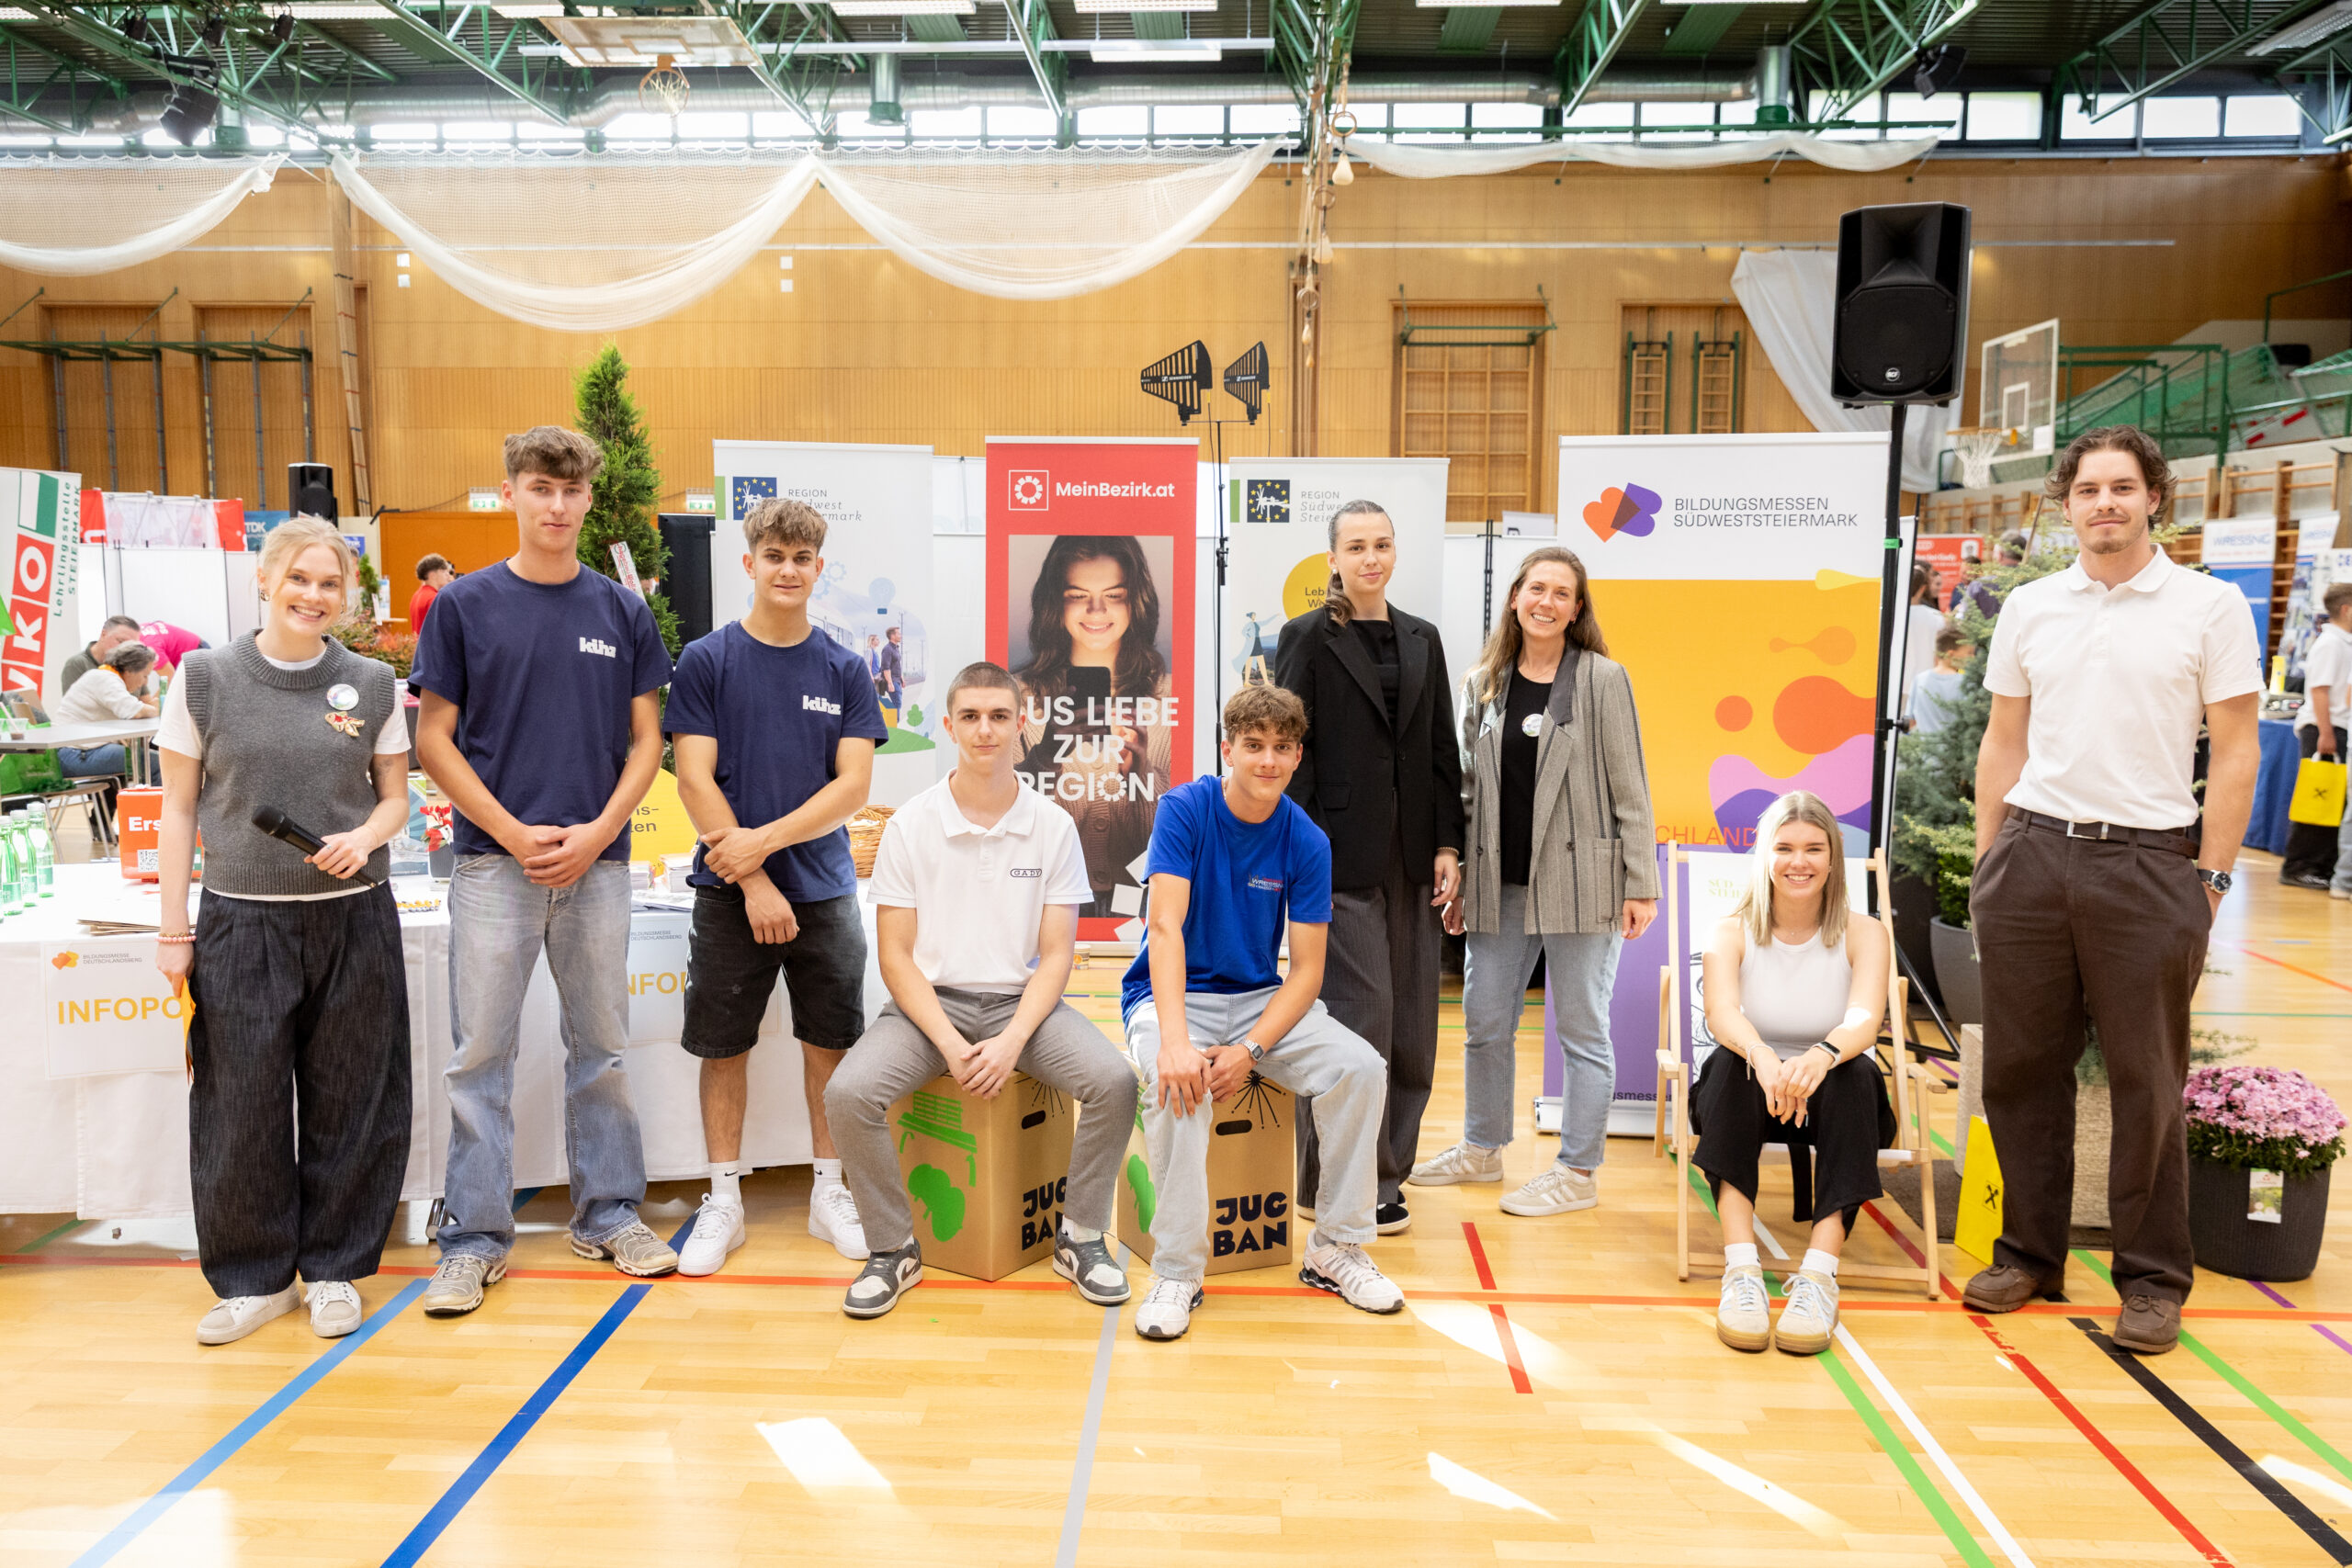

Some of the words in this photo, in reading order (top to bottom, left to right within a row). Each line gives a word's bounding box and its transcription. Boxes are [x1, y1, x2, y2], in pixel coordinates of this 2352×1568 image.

[788, 489, 828, 497] REGION
[1056, 480, 1175, 498] MeinBezirk.at
[1301, 491, 1340, 500] REGION
[1675, 497, 1828, 512] BILDUNGSMESSEN
[1674, 512, 1858, 527] SÜDWESTSTEIERMARK
[53, 481, 71, 617] Lehrlingsstelle
[1305, 587, 1325, 596] Leb
[1087, 696, 1179, 727] LIEBE
[1053, 734, 1125, 764] ZUR
[631, 822, 657, 833] en
[1216, 1191, 1288, 1226] JUG
[1213, 1221, 1287, 1258] BAN
